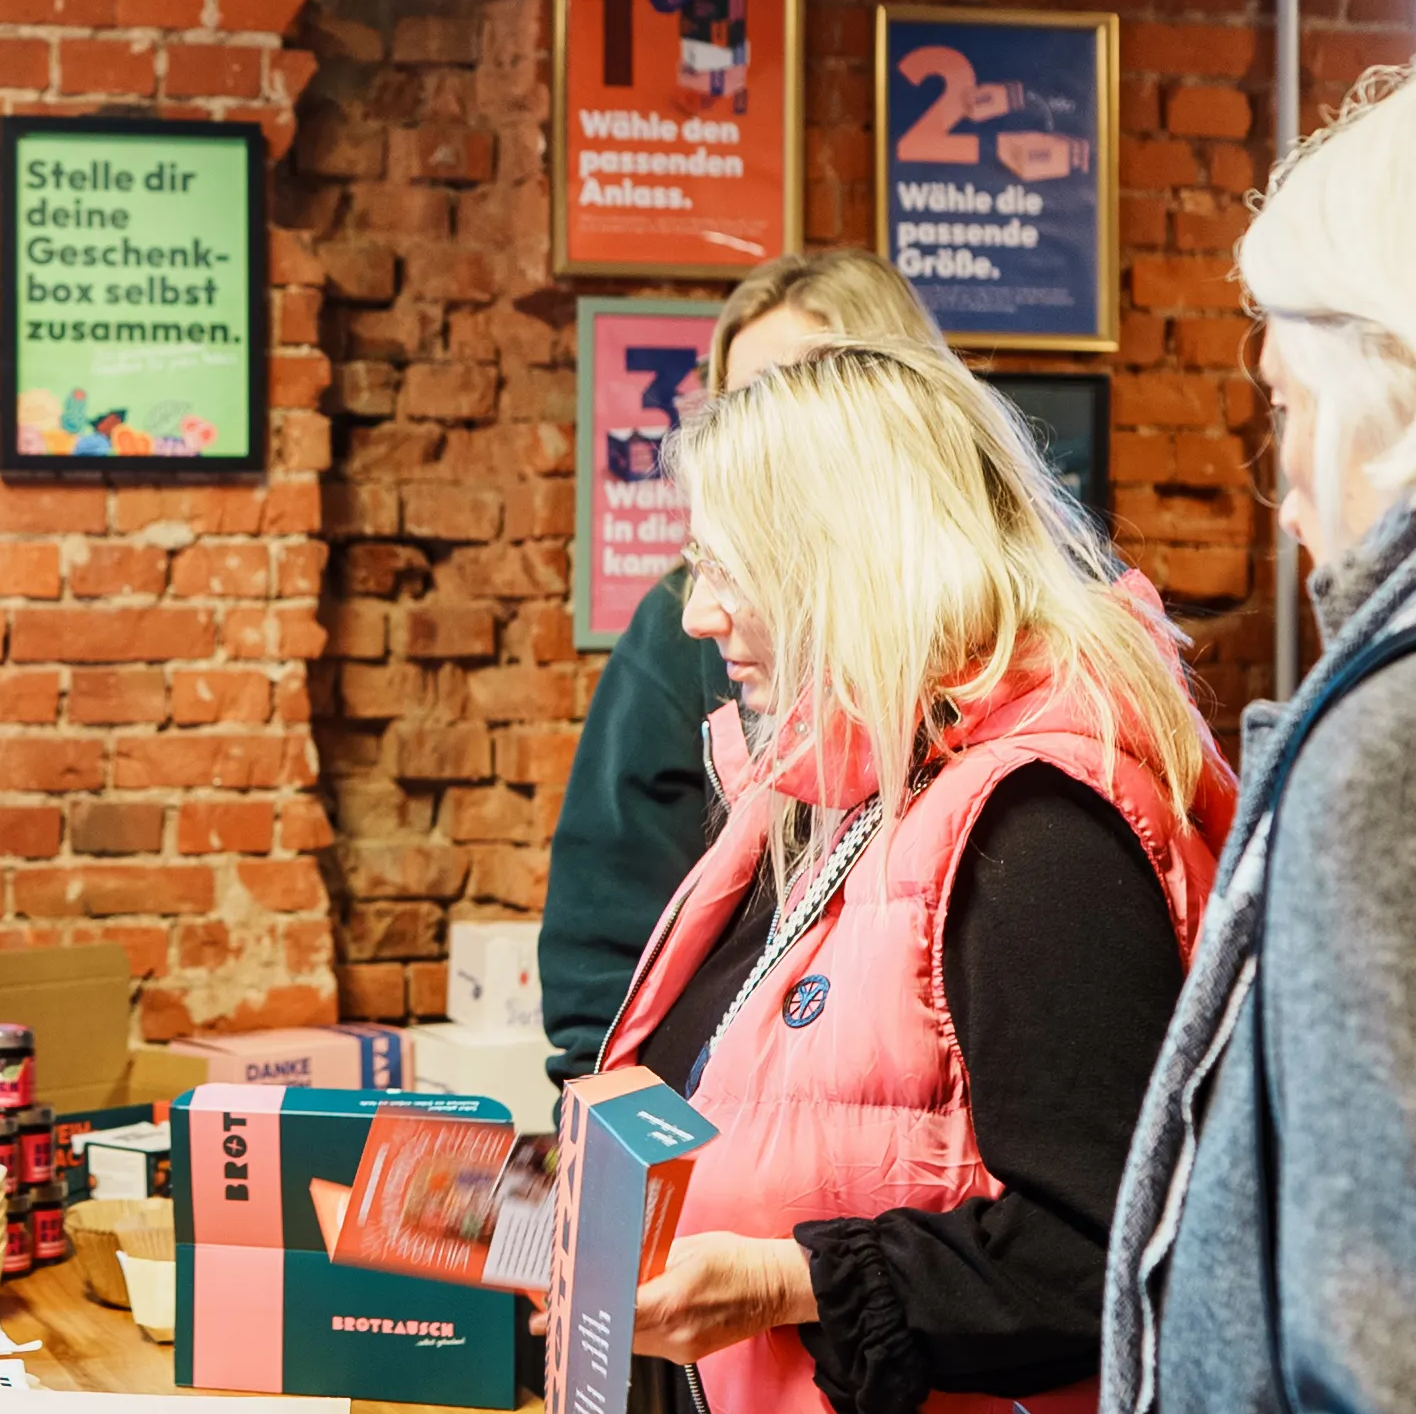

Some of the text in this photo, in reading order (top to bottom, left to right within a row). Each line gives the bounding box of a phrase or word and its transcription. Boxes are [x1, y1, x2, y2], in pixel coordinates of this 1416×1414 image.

[897, 45, 980, 165] 2
[580, 109, 740, 144] Wähle den
[26, 159, 197, 193] Stelle dir
[579, 147, 744, 180] passenden
[578, 178, 693, 209] Anlass.
[897, 181, 1044, 215] Wähle die
[26, 197, 129, 229] deine
[897, 217, 1039, 250] passende
[26, 236, 231, 269] Geschenk-
[897, 247, 1001, 280] Größe.
[26, 273, 220, 307] box selbst
[26, 319, 242, 344] zusammen.
[604, 511, 633, 544] in
[245, 1056, 311, 1081] DANKE
[223, 1112, 249, 1201] BROT
[332, 1316, 454, 1337] BROTRAUSCH
